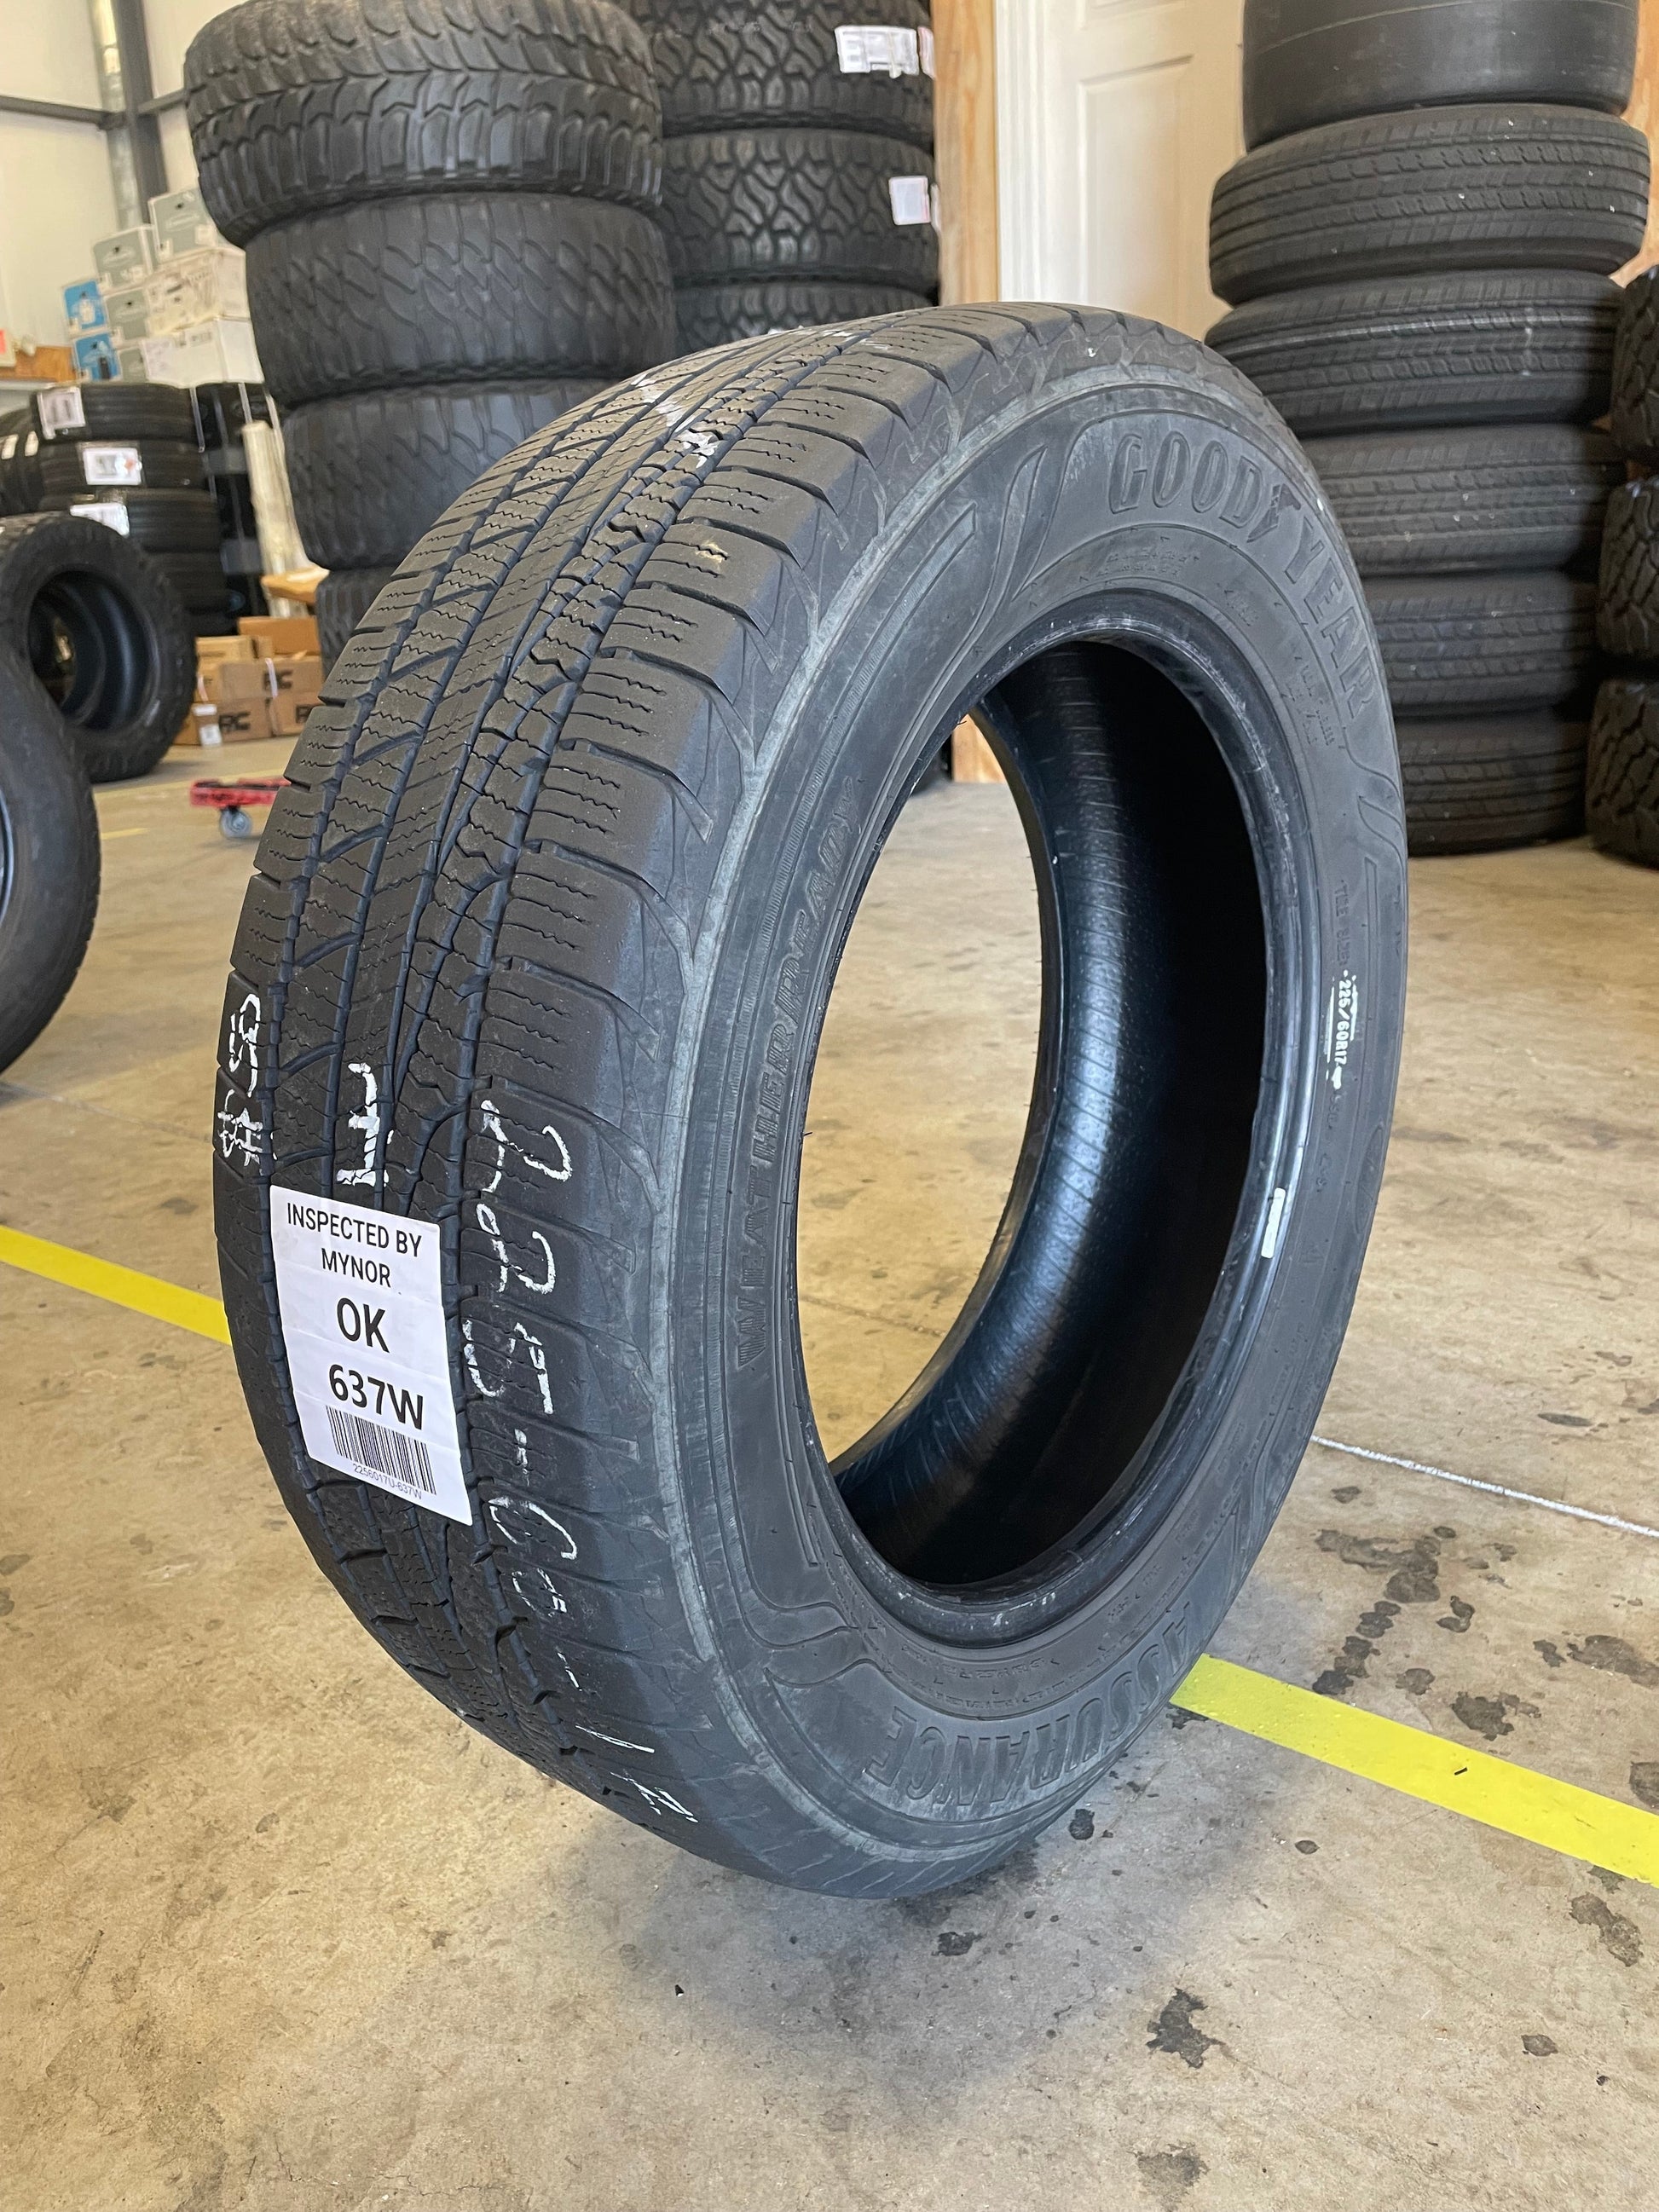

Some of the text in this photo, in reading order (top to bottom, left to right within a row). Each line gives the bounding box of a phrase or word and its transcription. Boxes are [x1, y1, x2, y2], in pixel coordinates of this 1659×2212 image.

[287, 1202, 422, 1257] INSPECTED BY
[321, 1248, 391, 1288] MYNOR
[337, 1297, 390, 1354] OK
[329, 1364, 424, 1430] 637W
[353, 1464, 422, 1499] 2256017U-637W
